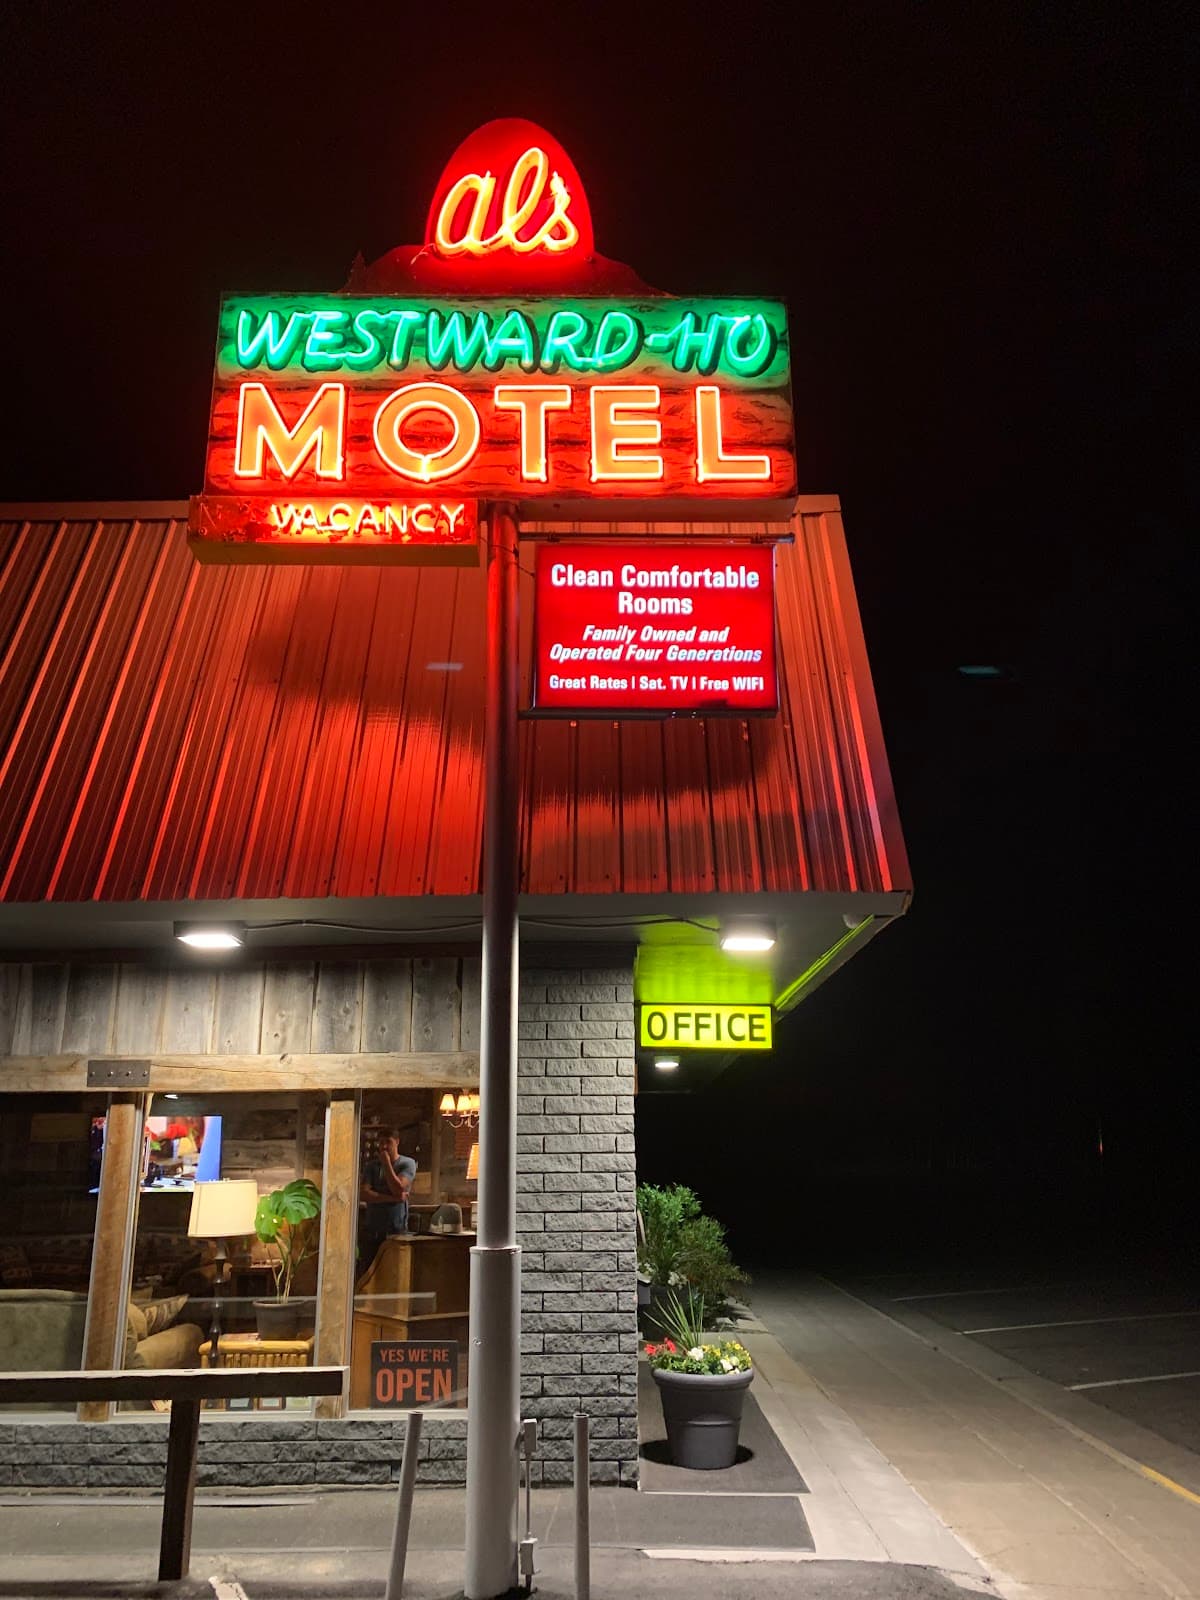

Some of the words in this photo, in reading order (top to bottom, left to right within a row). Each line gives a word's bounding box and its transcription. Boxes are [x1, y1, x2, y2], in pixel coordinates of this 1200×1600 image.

[235, 309, 777, 376] WESTWARD-HO
[232, 381, 772, 483] MOTEL
[270, 502, 466, 533] VACANCY
[551, 563, 614, 587] Clean
[621, 564, 760, 589] Comfortable
[618, 591, 693, 615] Rooms
[582, 625, 636, 644] Family
[640, 626, 697, 642] Owned
[699, 626, 730, 643] and
[549, 643, 622, 663] Operated
[625, 645, 663, 661] Four
[666, 646, 762, 663] Generations
[549, 675, 586, 690] Great
[590, 676, 628, 690] Rates
[639, 676, 666, 690] Sat.
[670, 677, 689, 690] TV
[700, 677, 729, 691] Free
[732, 677, 764, 692] WIFI
[647, 1011, 766, 1042] OFFICE
[380, 1348, 405, 1363] YES
[408, 1348, 449, 1363] WE'RE
[376, 1368, 452, 1402] OPEN
